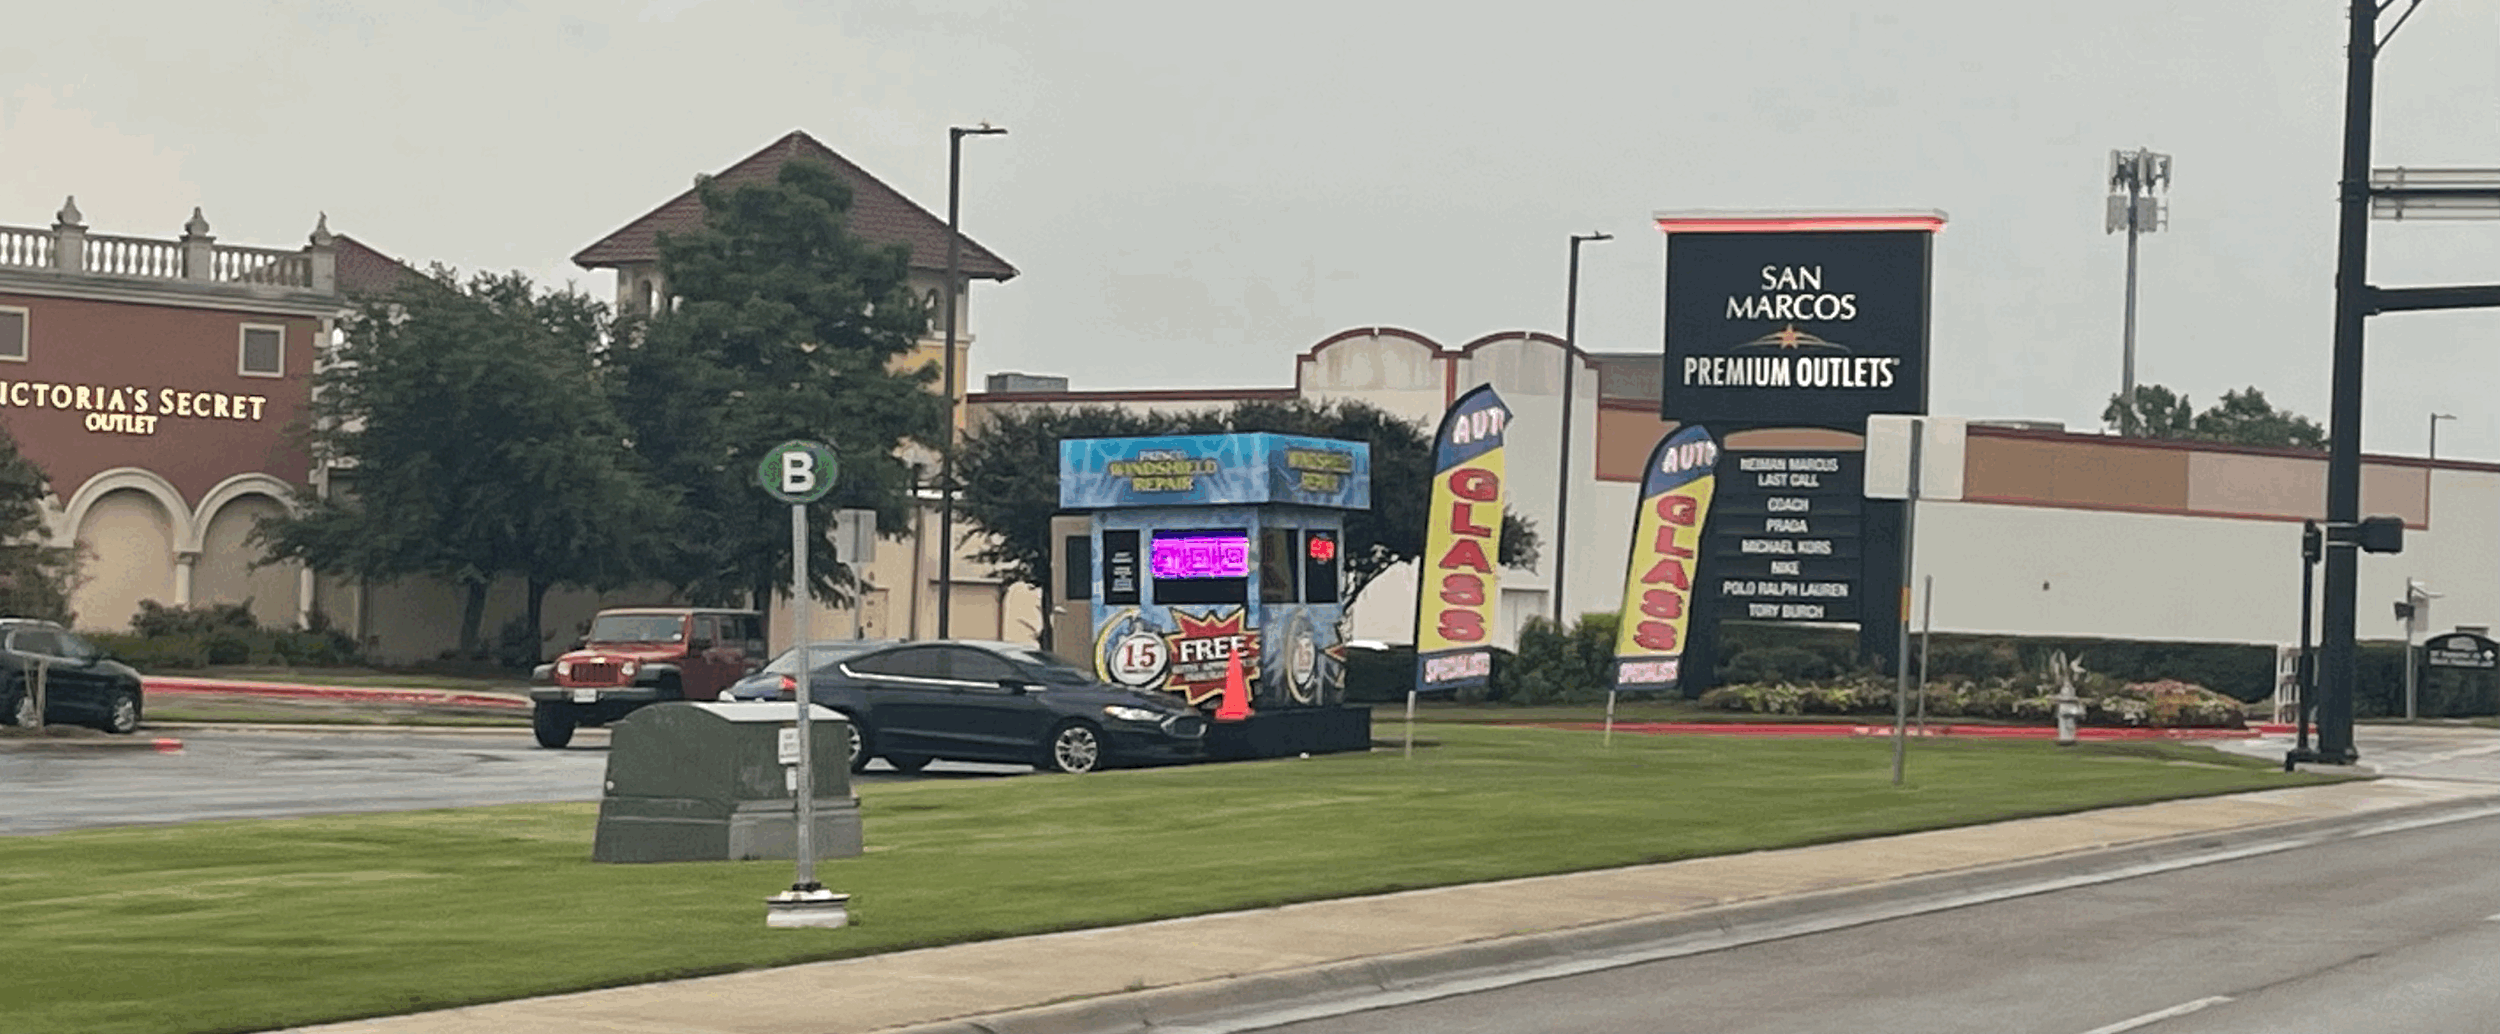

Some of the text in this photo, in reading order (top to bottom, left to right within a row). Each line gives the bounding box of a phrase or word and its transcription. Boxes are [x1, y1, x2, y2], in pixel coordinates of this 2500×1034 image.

[1761, 265, 1821, 291] SAN
[1726, 294, 1857, 320] MARCOS
[1683, 356, 1791, 386] PREMIUM
[0, 381, 267, 420] ICTORIA'S SECRET
[85, 412, 158, 435] OUTLET
[782, 451, 816, 493] B
[1788, 457, 1839, 472] MARCUS
[1757, 473, 1820, 487] LAST CALL
[1767, 497, 1809, 512] COACH
[1765, 517, 1809, 533] PRADA
[1437, 467, 1500, 643] GLASS
[1741, 538, 1832, 555] MICHAEL KORS
[1632, 494, 1698, 651] GLASS
[1722, 580, 1849, 597] POLO RALPH LAUREN
[1748, 602, 1825, 619] TORY BURCH
[1123, 642, 1156, 668] 15
[1180, 636, 1250, 663] FREE
